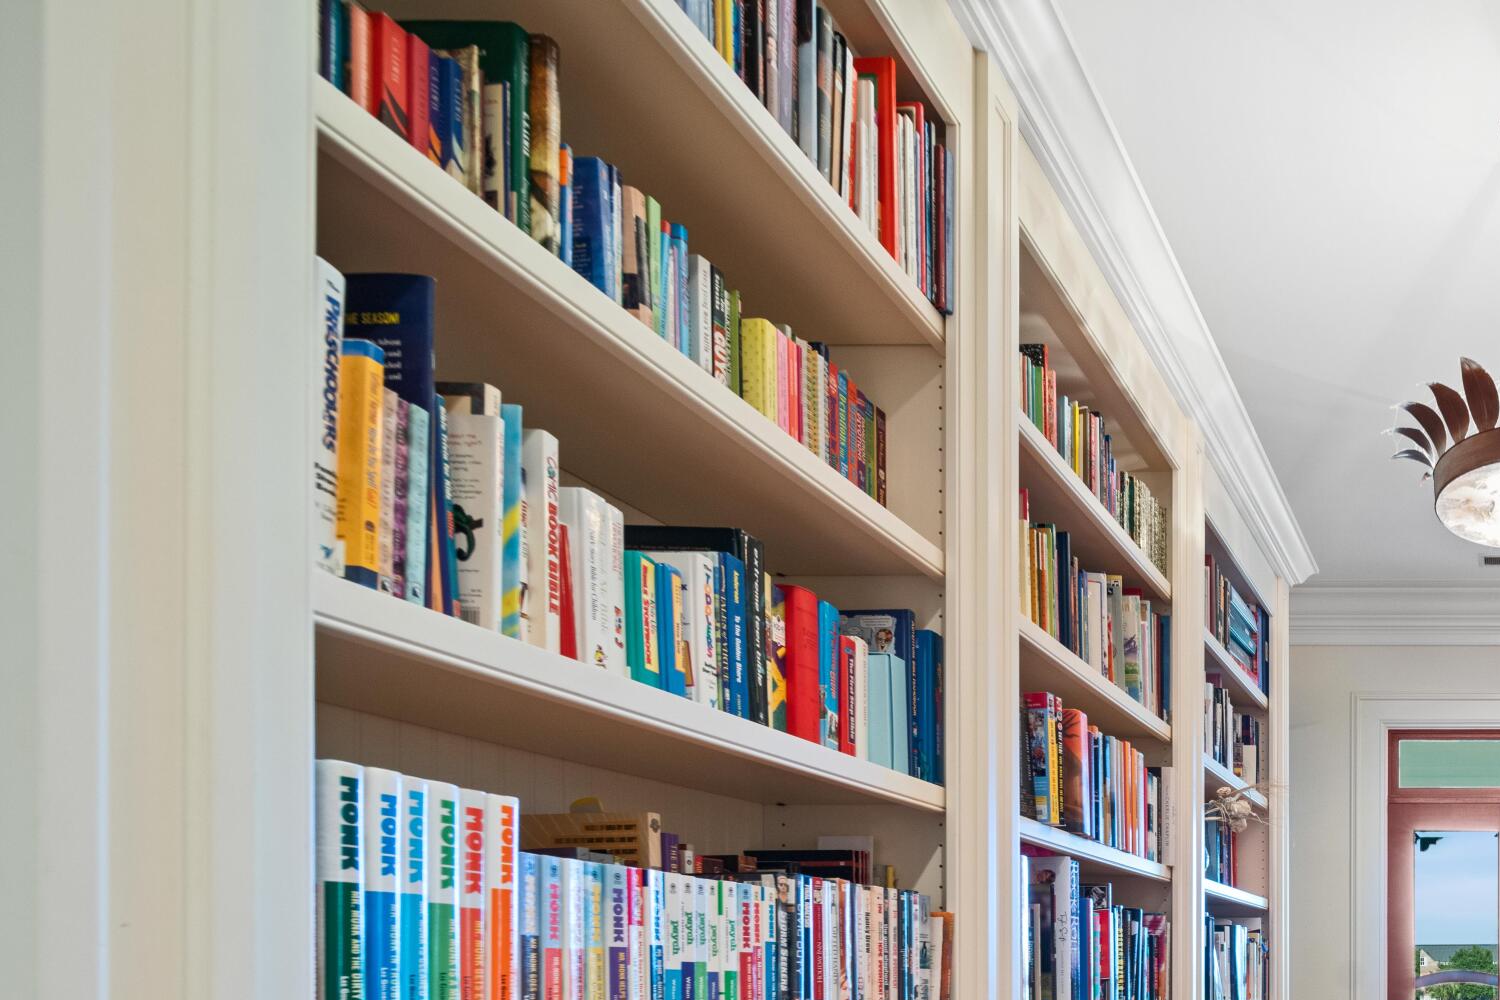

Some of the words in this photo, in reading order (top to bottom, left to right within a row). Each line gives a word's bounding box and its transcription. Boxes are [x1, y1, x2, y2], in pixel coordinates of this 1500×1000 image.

[323, 295, 341, 453] PRESCHOOLERS
[441, 433, 449, 461] Trivia
[368, 471, 377, 488] Spell
[548, 502, 558, 557] BOOK
[549, 559, 560, 615] BIBLE
[756, 651, 765, 686] bible
[340, 776, 359, 870] MONK
[381, 793, 397, 877] MONK
[409, 790, 425, 883] MONK
[440, 799, 455, 889] MONK
[465, 806, 483, 894] MONK
[501, 804, 514, 884] MONK
[350, 891, 360, 908] MR.
[550, 884, 559, 941] MONK
[613, 888, 624, 942] MONK
[351, 910, 361, 936] MONK
[670, 920, 680, 955] psych
[685, 912, 693, 945] psych
[711, 925, 719, 957] psych
[742, 902, 750, 948] MONK
[780, 911, 788, 946] STORM
[351, 938, 362, 955] AND
[351, 956, 362, 970] THE
[473, 939, 482, 966] MONK
[351, 973, 363, 1000] DIRTY
[780, 948, 789, 991] SEEKERS
